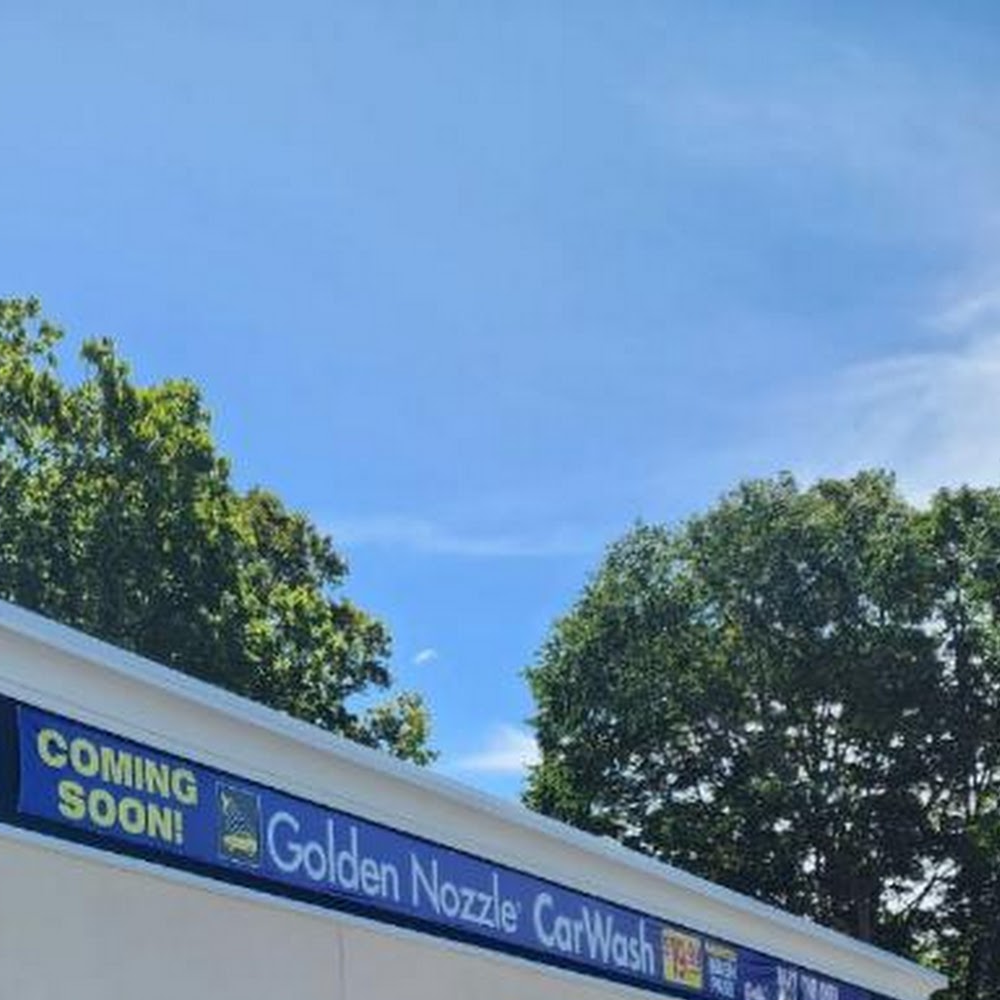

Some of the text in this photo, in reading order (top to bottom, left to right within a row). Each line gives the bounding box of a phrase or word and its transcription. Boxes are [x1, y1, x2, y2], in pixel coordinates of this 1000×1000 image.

[37, 728, 198, 806] COMING
[58, 780, 183, 845] SOON!
[267, 812, 399, 901] Golden
[411, 853, 517, 932] Nozzle
[534, 893, 654, 975] CarWash
